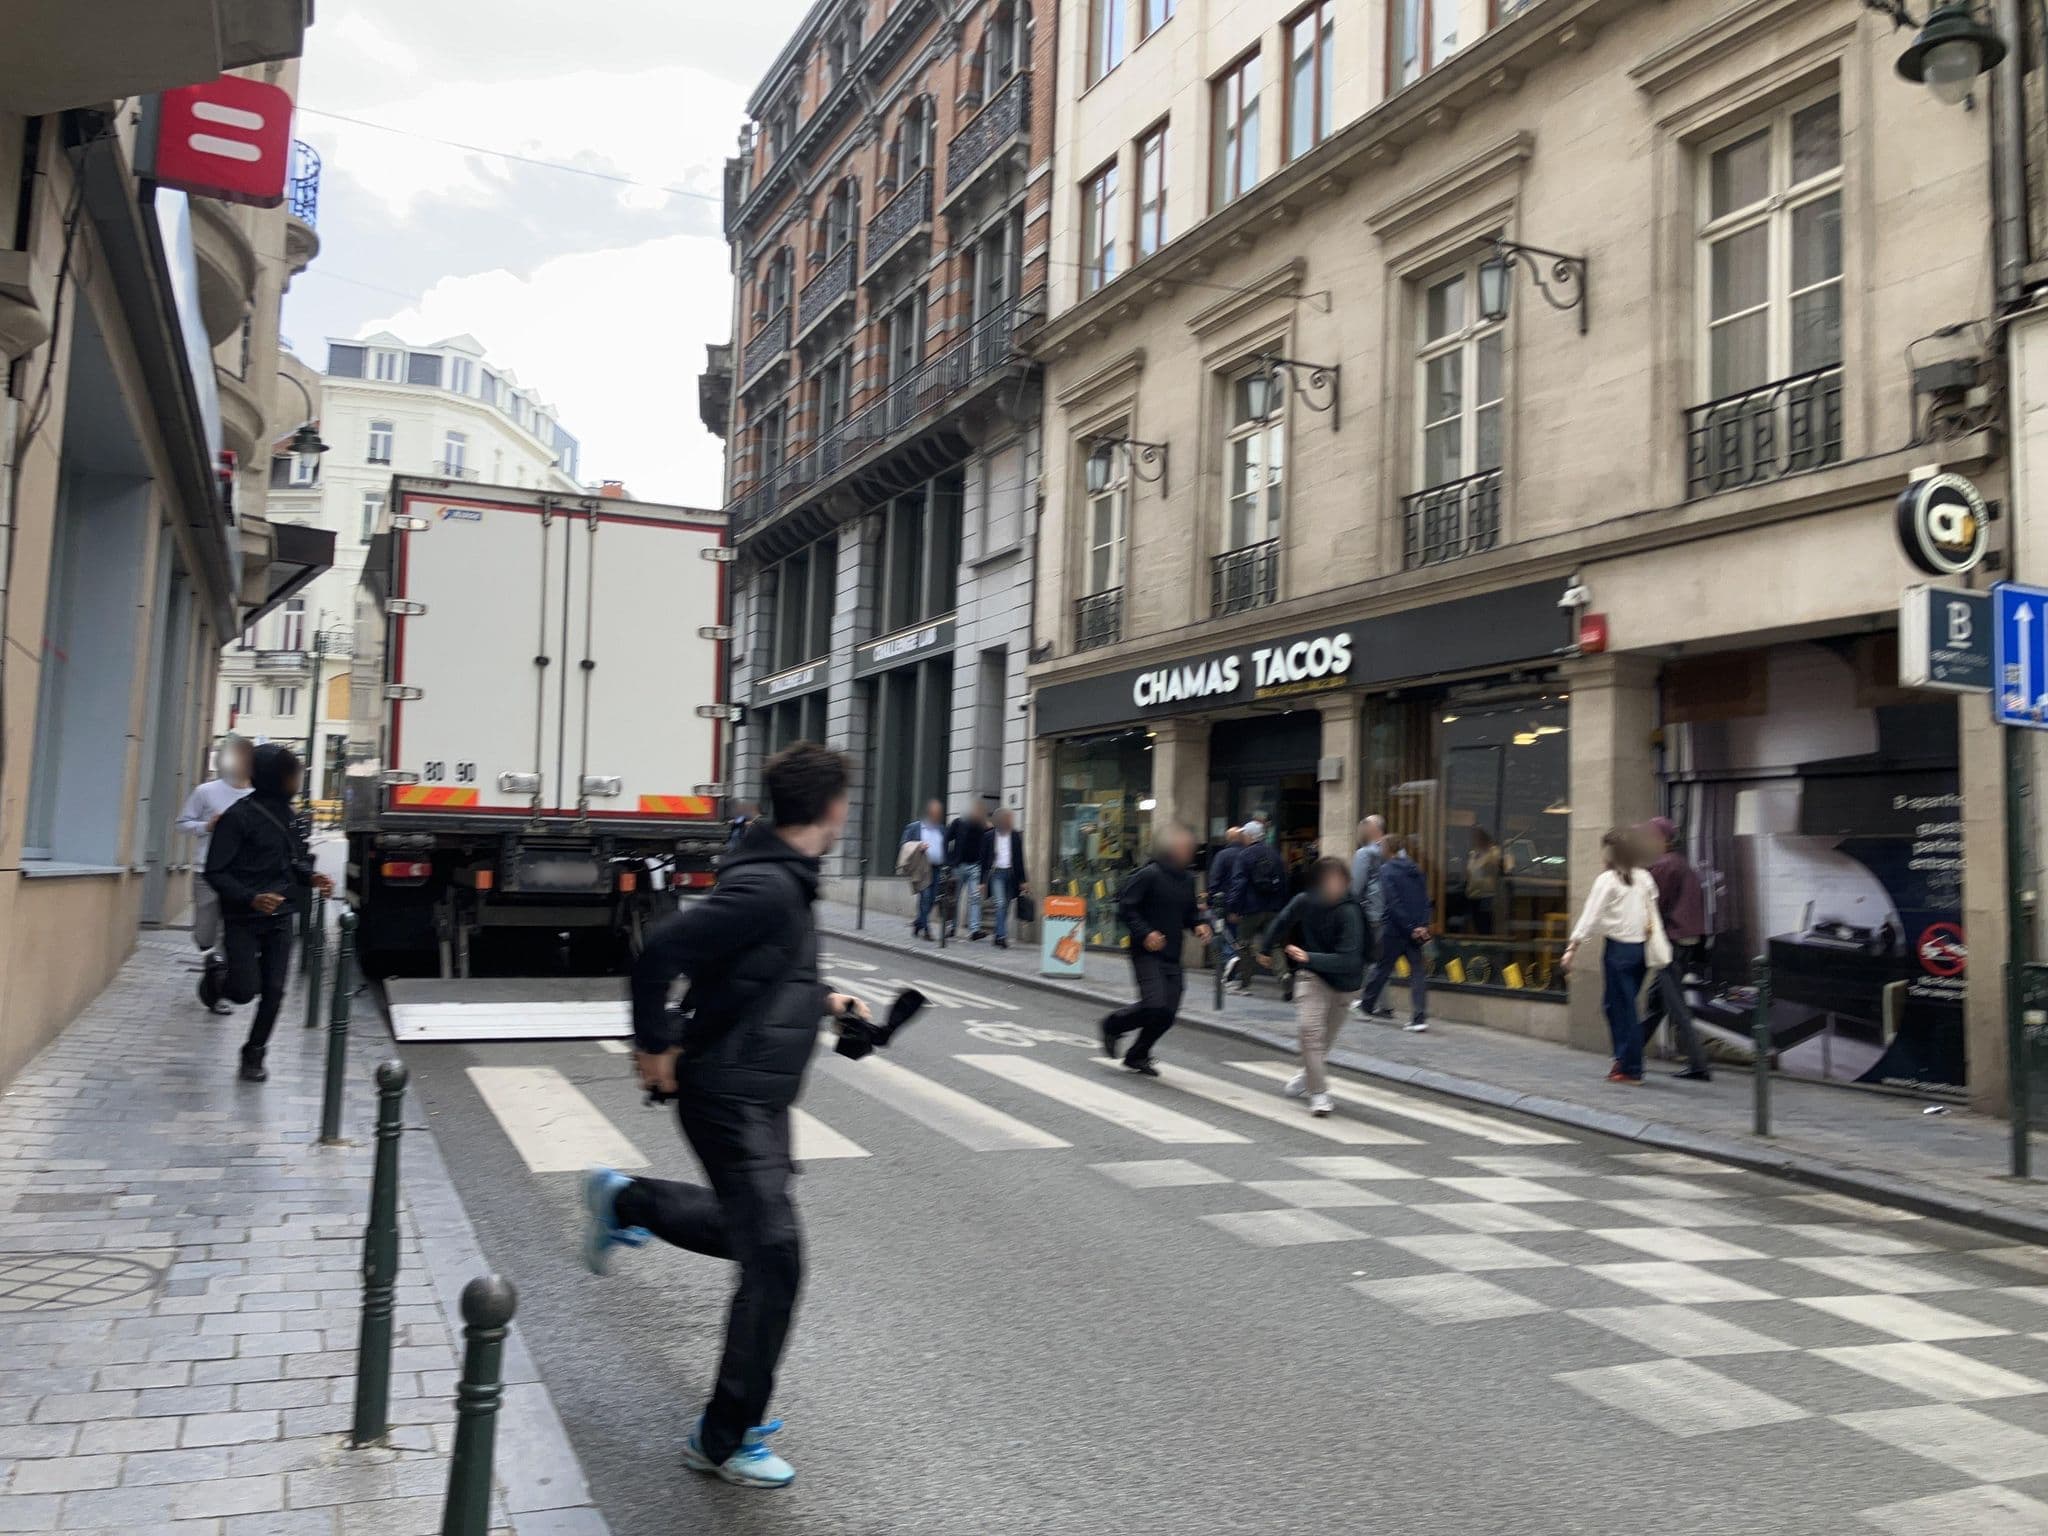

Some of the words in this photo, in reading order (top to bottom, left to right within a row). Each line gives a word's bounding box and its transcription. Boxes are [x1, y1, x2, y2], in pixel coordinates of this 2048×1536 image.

[1946, 601, 1973, 641] B
[1133, 655, 1241, 708] CHAMAS
[1251, 632, 1354, 688] TACOS
